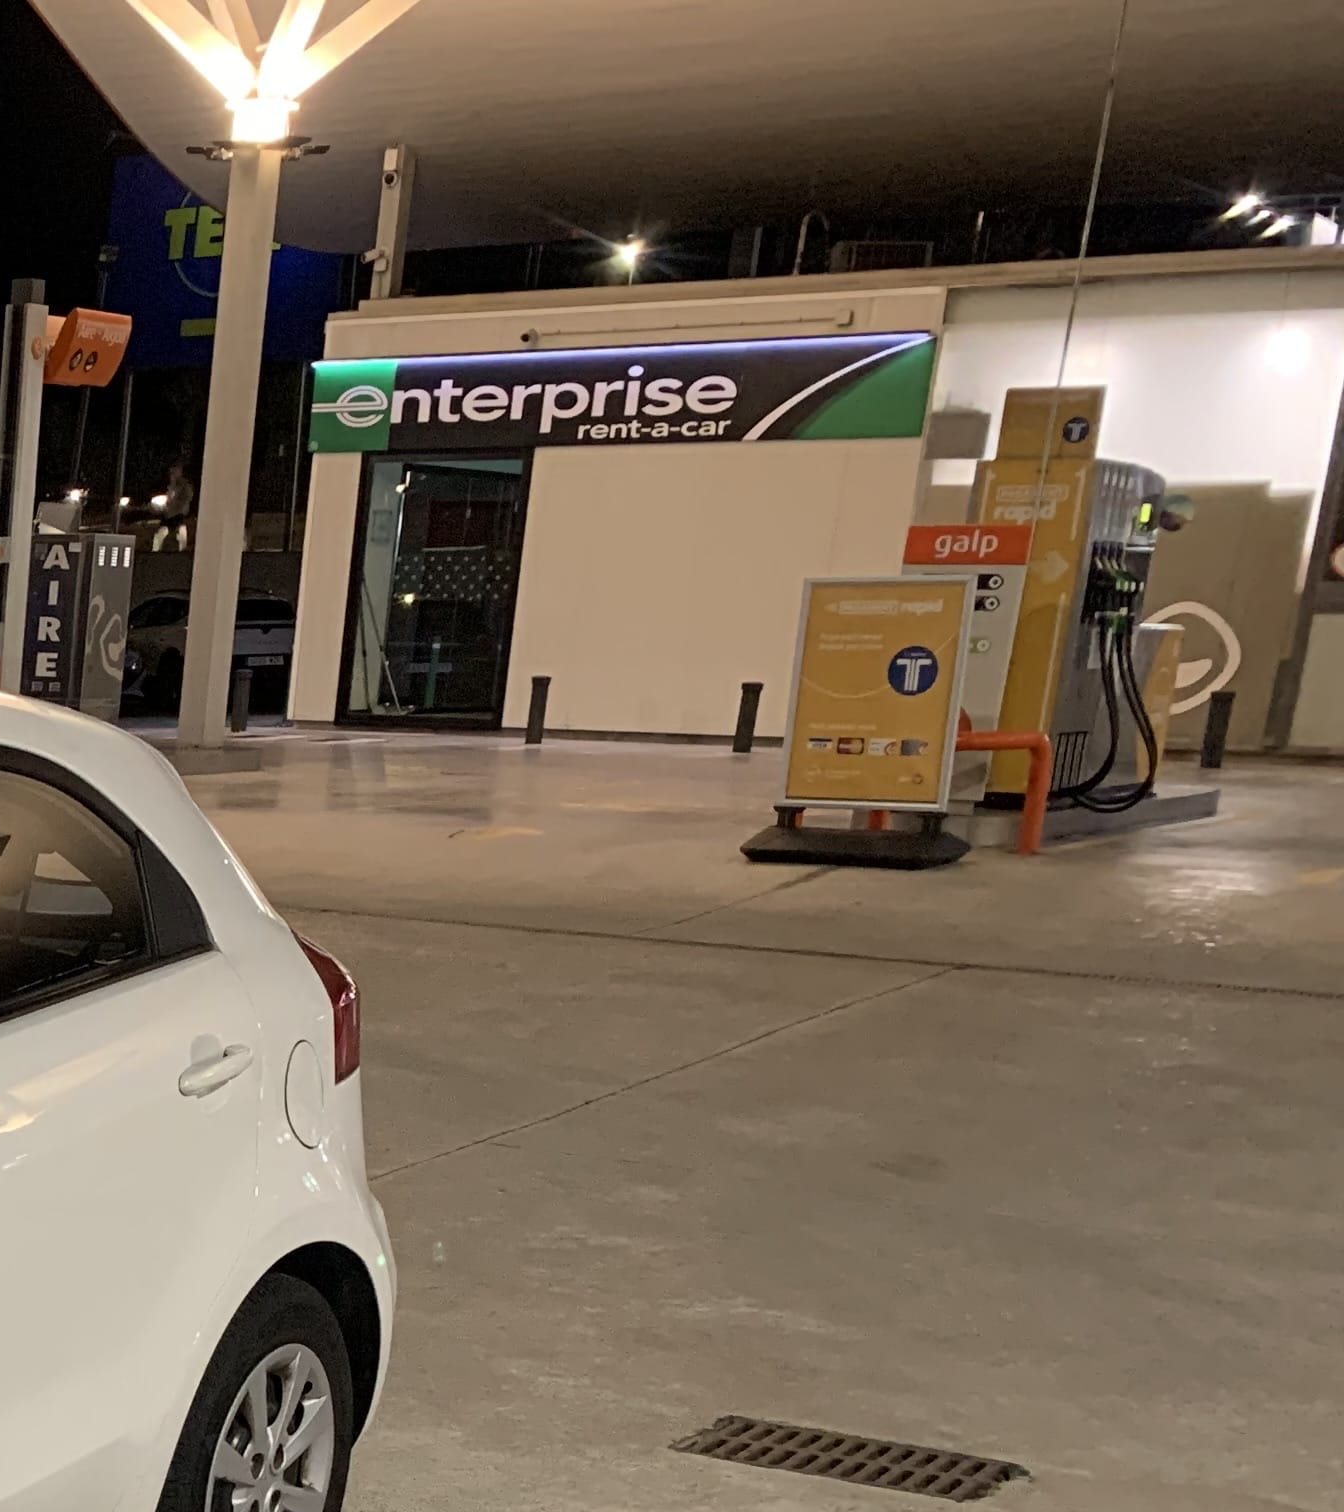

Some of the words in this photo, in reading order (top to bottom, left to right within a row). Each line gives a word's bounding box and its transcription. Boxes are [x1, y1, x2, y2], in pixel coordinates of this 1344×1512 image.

[334, 365, 738, 434] enterprise
[577, 417, 732, 440] rent-a-car
[934, 528, 999, 558] galp
[34, 544, 70, 678] AIRE
